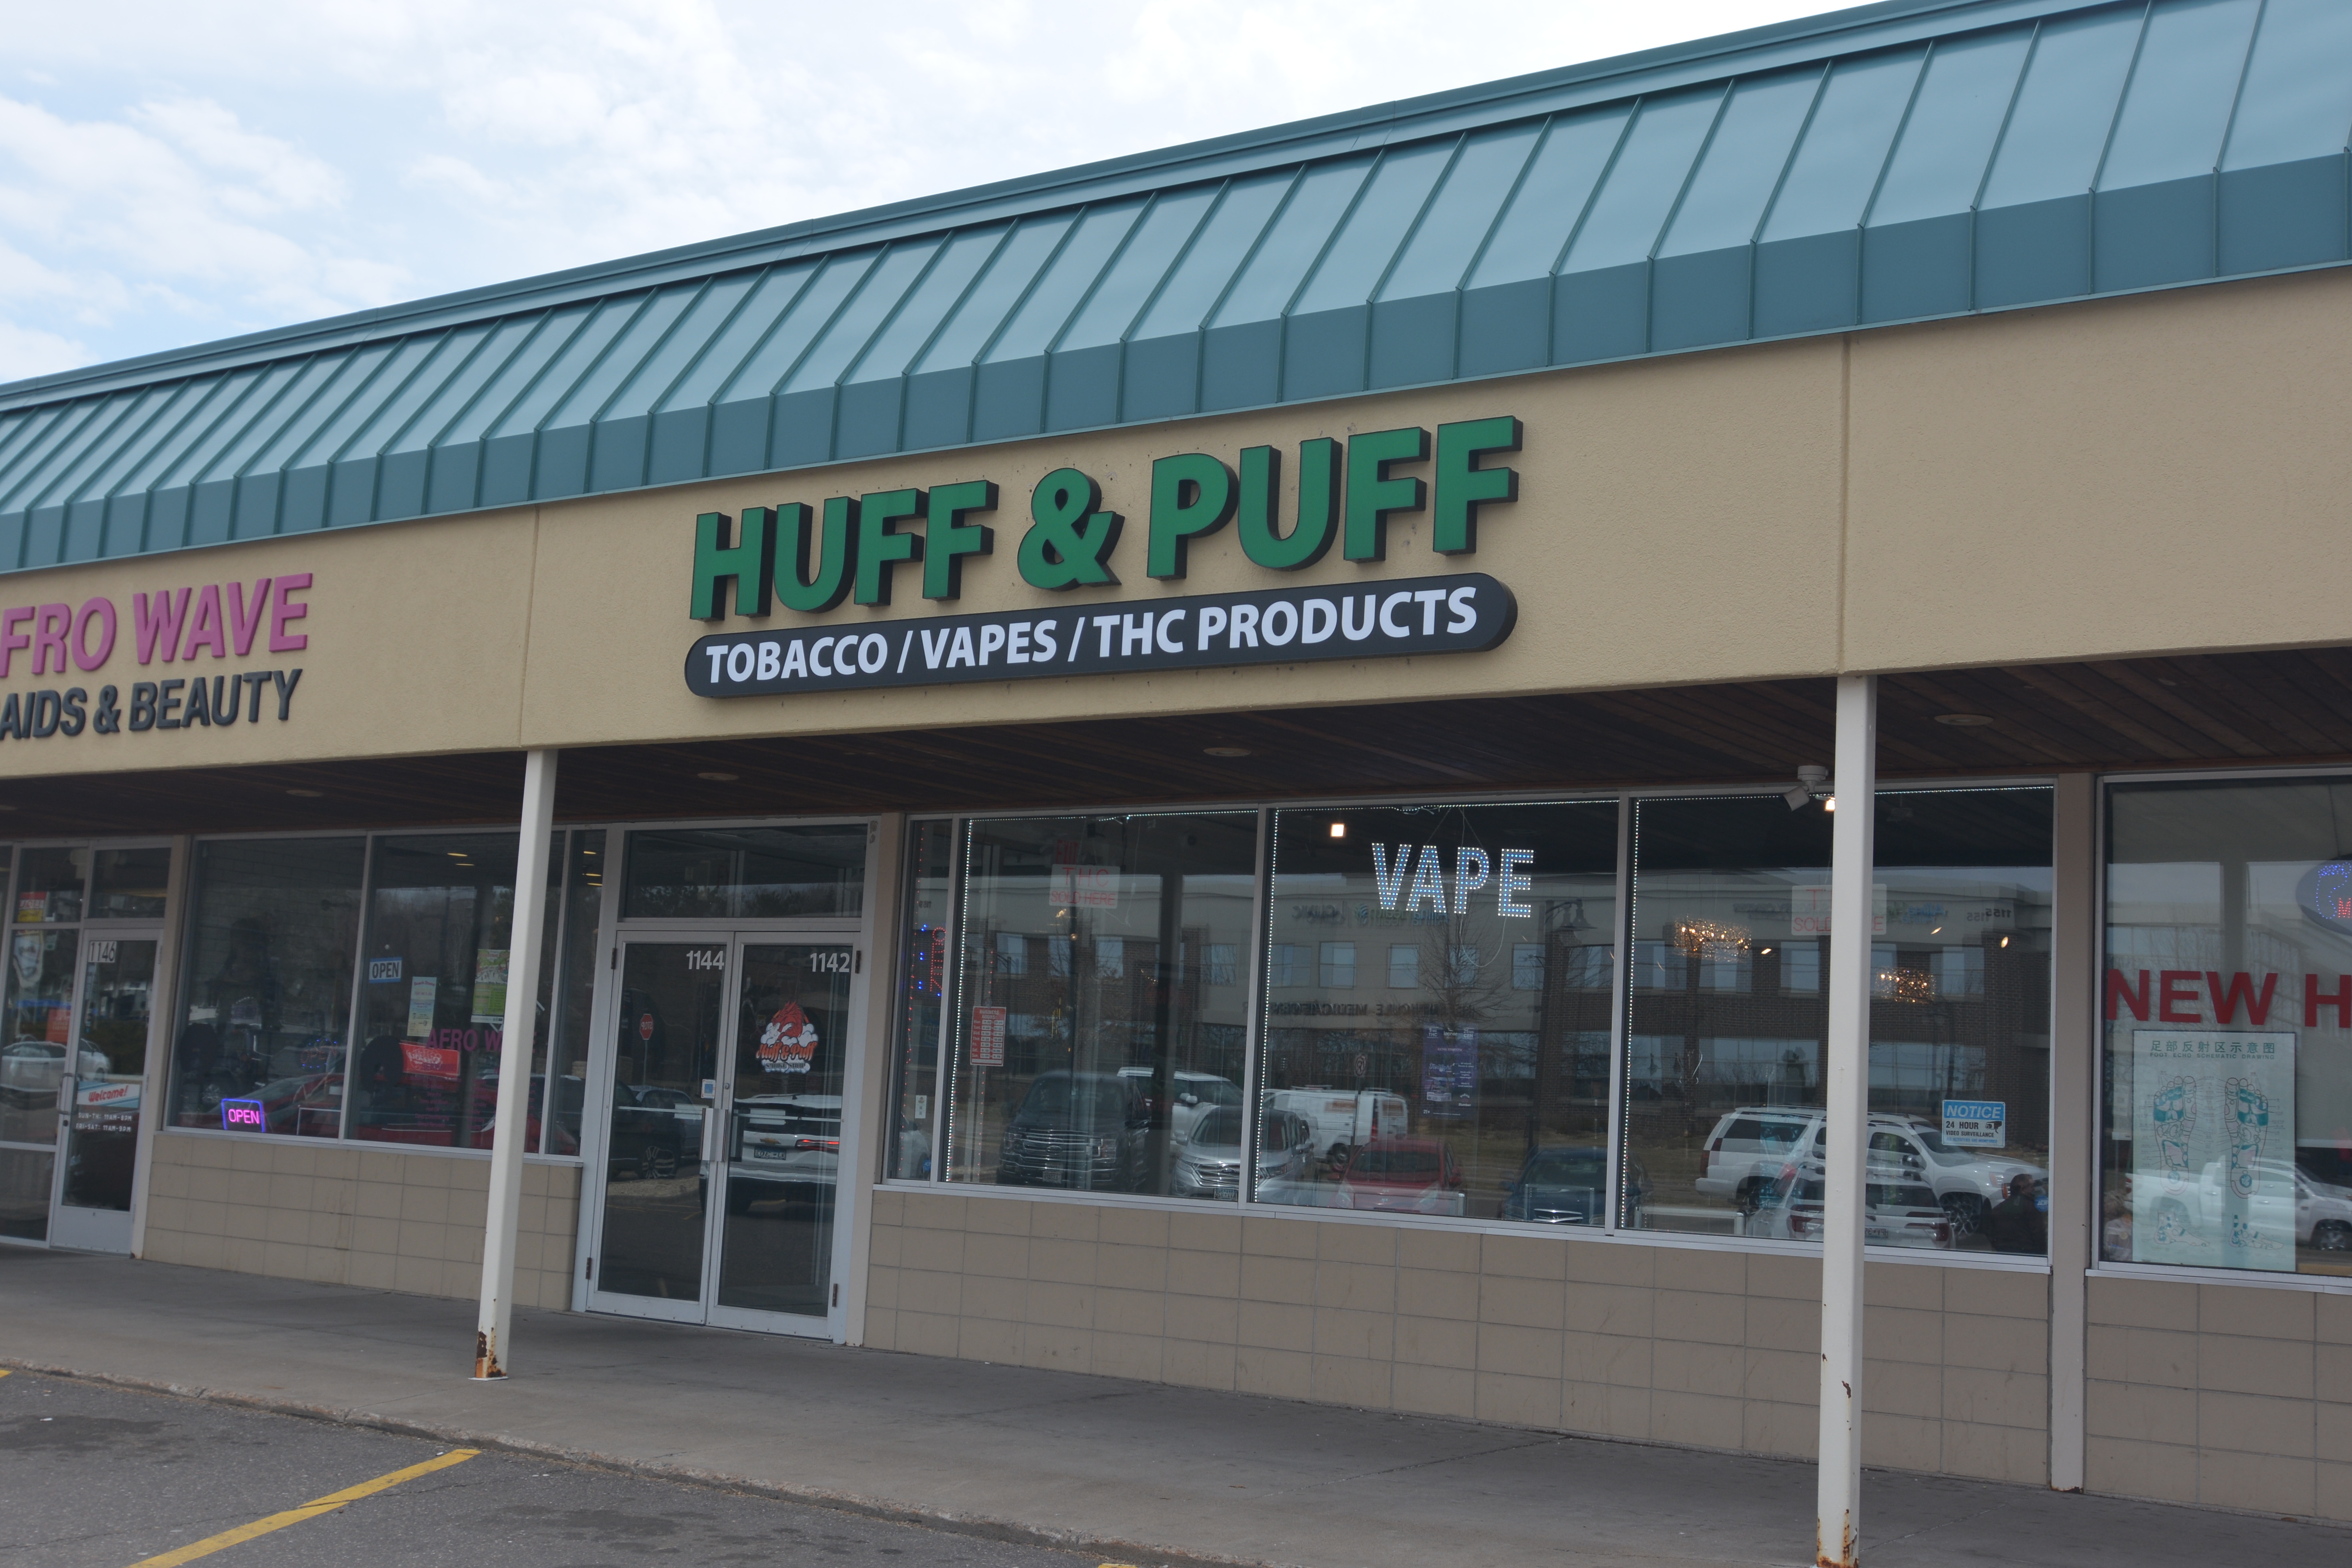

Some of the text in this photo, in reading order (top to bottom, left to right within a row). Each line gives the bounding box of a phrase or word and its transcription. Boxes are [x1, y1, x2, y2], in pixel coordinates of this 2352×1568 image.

[690, 416, 1523, 622] HUFF & PUFF
[133, 573, 313, 664] WAVE
[706, 633, 887, 683] TOBACCO
[921, 620, 1057, 669] VAPES
[1093, 610, 1186, 658] THC
[1198, 587, 1477, 651] PRODUCTS
[93, 685, 121, 734] &
[128, 669, 303, 731] BEAUTY
[1372, 842, 1535, 918] VAPE
[1051, 891, 1116, 906] SOLD HERE
[90, 941, 116, 962] 1146
[686, 950, 850, 973] 1144 1142
[372, 962, 399, 979] OPEN
[2107, 969, 2279, 1025] NEW
[425, 1028, 478, 1052] AFRO
[2151, 1040, 2275, 1054] 足部反射区示意图
[756, 1041, 783, 1061] Huff
[790, 1041, 818, 1061] Puff
[88, 1084, 129, 1103] Welcome!
[228, 1108, 261, 1125] OPEN
[1946, 1105, 2002, 1119] NOTICE
[1959, 1121, 1979, 1129] HOUR
